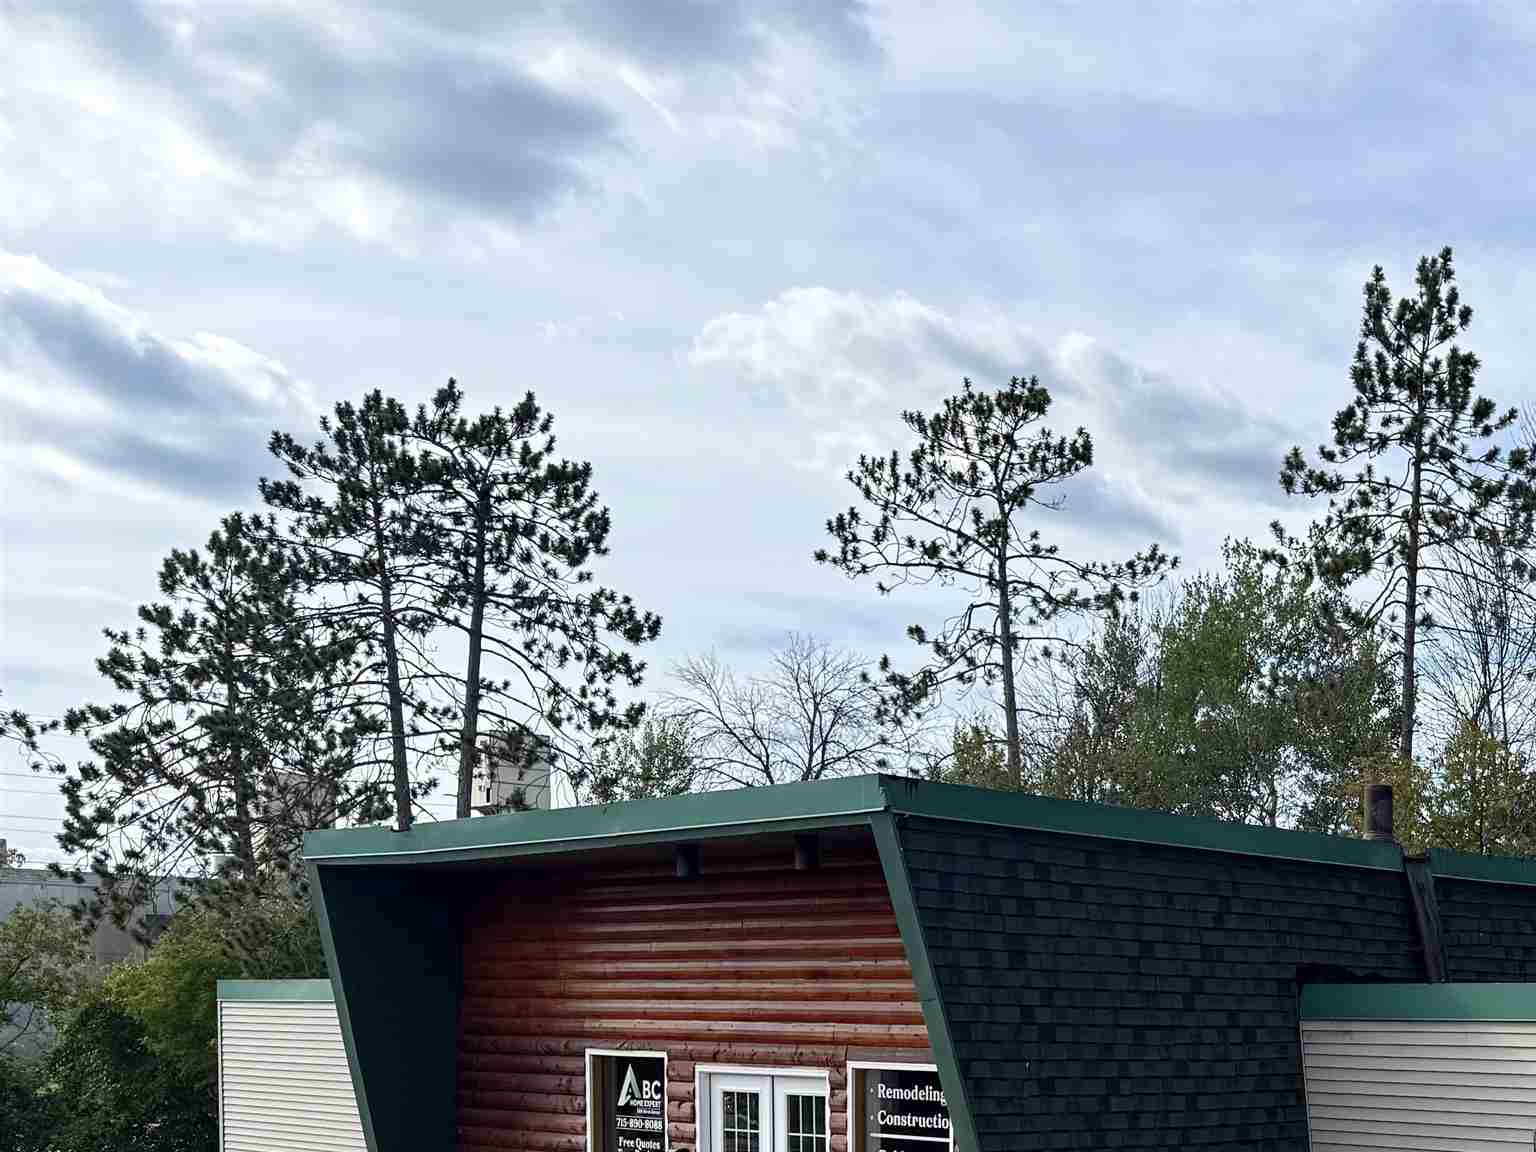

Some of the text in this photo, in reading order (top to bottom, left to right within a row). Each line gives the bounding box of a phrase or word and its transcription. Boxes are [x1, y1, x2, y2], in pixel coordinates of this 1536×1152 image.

[617, 1063, 661, 1106] ABC
[877, 1083, 947, 1106] Remodeling
[877, 1110, 950, 1129] Constructio
[618, 1136, 661, 1150] Free Quotes
